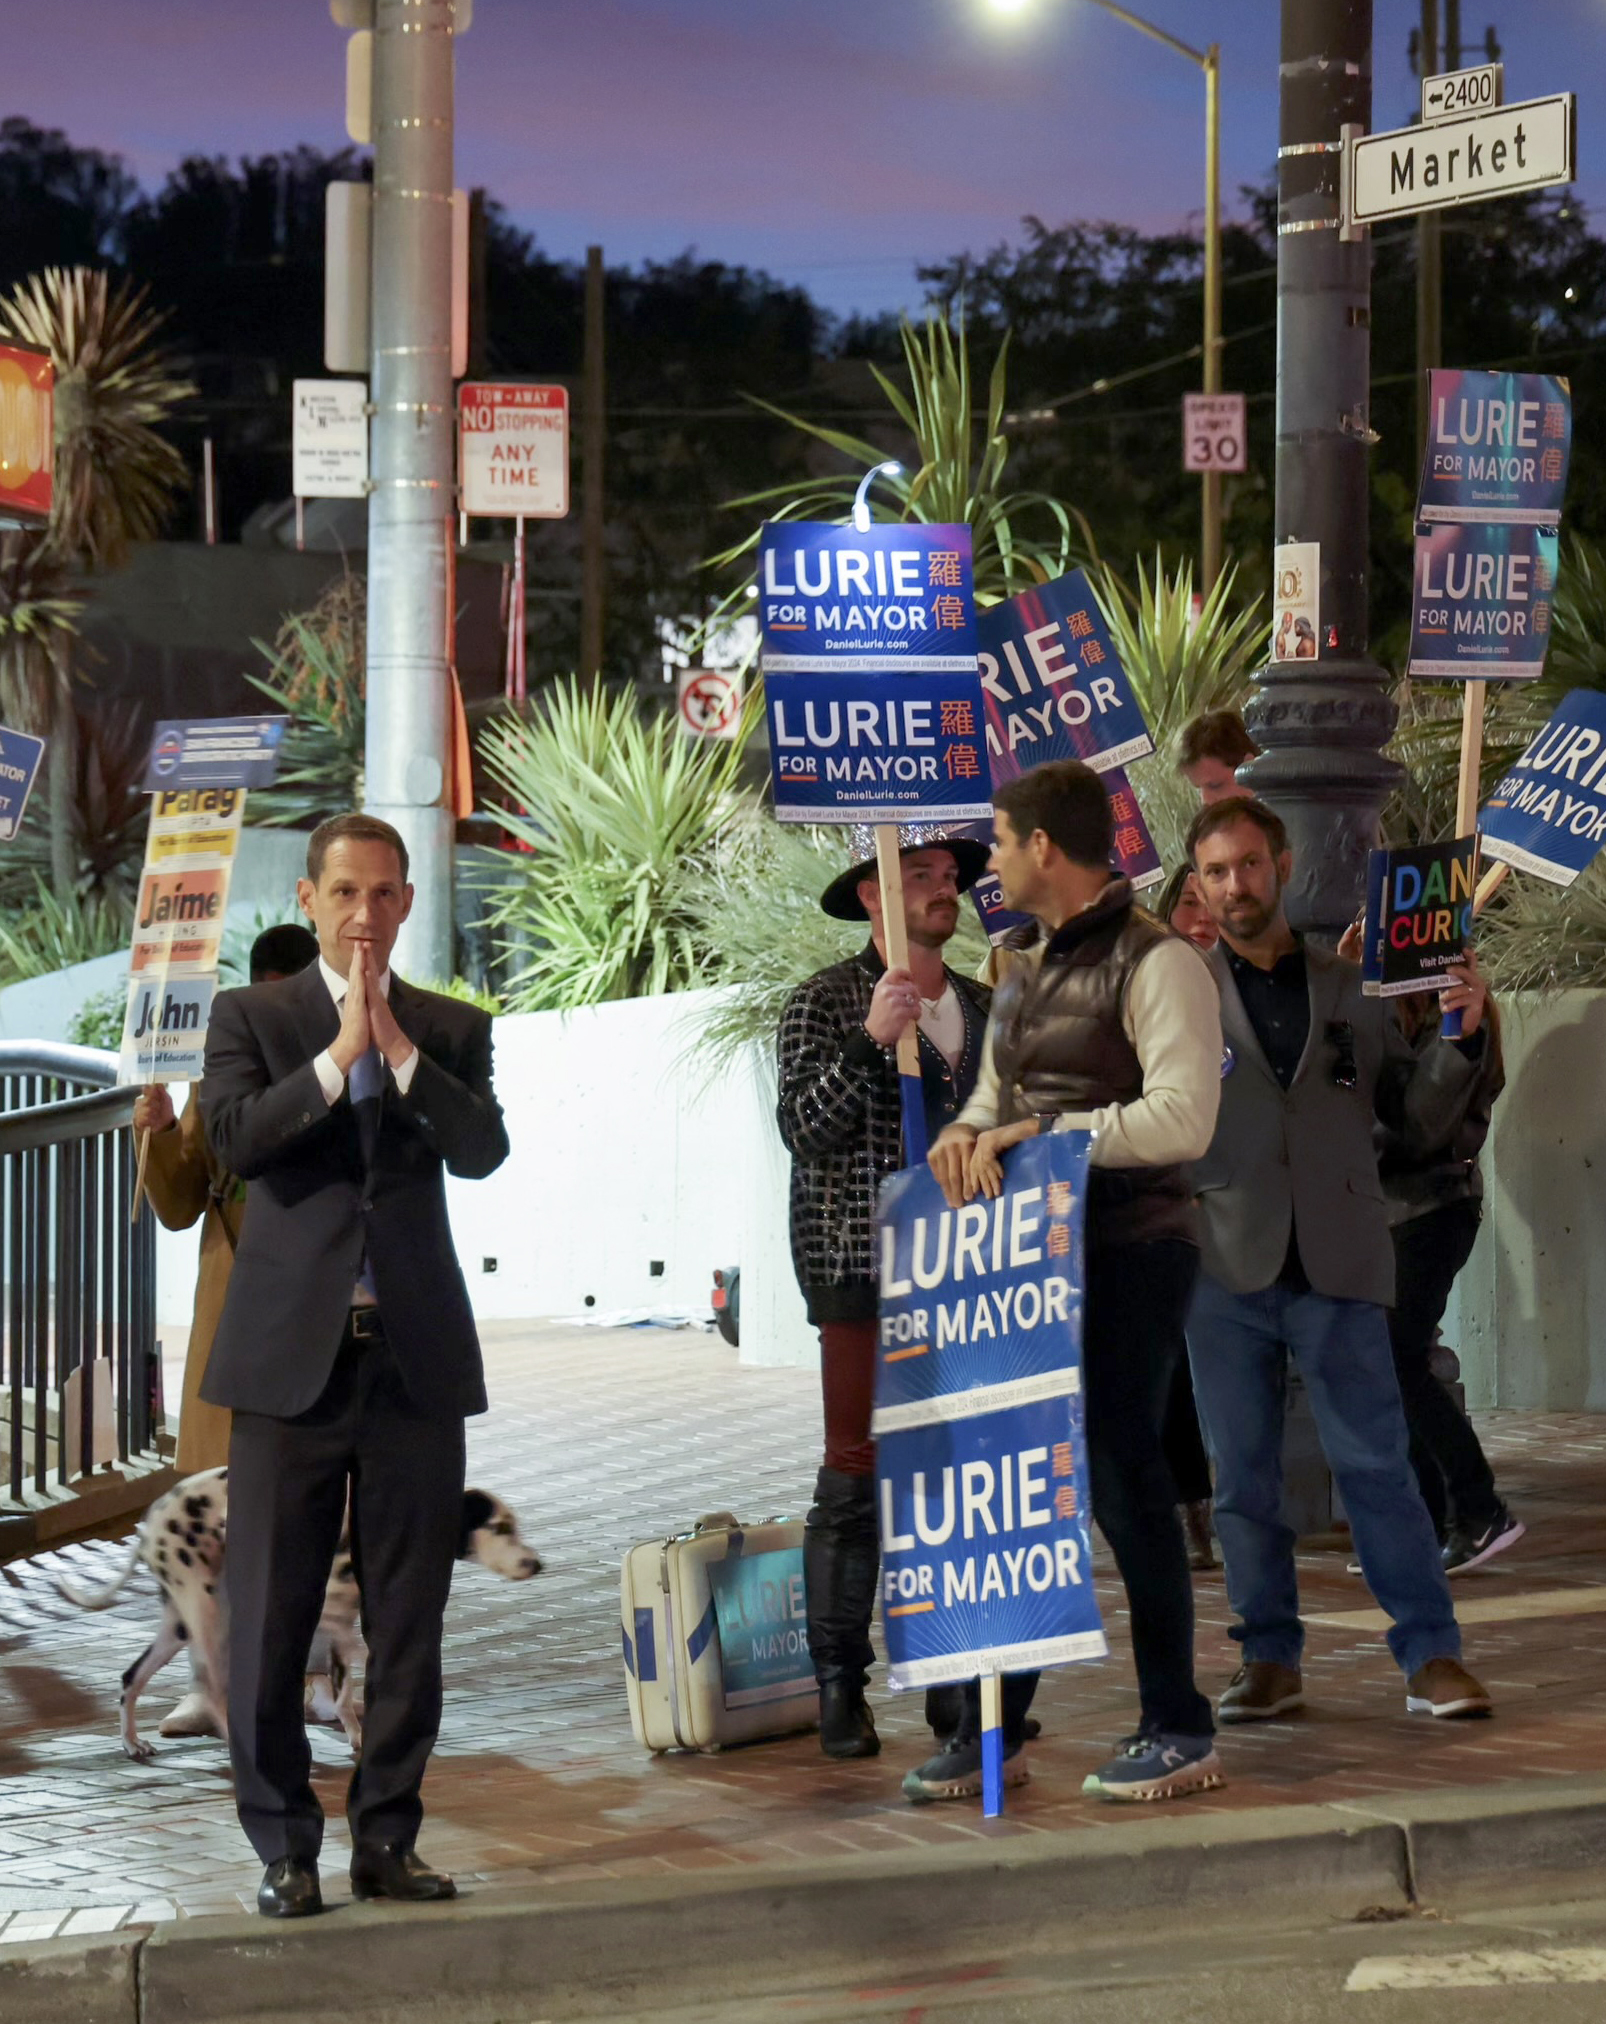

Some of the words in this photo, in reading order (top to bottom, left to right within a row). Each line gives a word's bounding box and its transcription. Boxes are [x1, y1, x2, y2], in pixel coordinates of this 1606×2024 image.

[1444, 73, 1491, 110] 2400
[1390, 123, 1526, 196] Market
[463, 406, 493, 431] NO
[496, 413, 562, 432] STOPPING
[1436, 397, 1541, 448] LURIE
[492, 444, 535, 461] ANY
[1193, 435, 1239, 464] 30
[489, 467, 539, 487] TIME
[1434, 454, 1463, 472] FOR
[1468, 456, 1535, 483] MAYOR
[764, 548, 924, 597] LURIE
[1421, 552, 1531, 601] LURIE
[767, 604, 807, 623] FOR
[815, 605, 928, 631] MAYOR
[1419, 608, 1448, 626] FOR
[1453, 609, 1526, 636] MAYOR
[825, 639, 908, 650] DanielLurie.com
[978, 621, 1079, 703] RIE
[773, 700, 936, 747] LURIE
[779, 756, 817, 773] FOR
[826, 756, 939, 781] MAYOR
[158, 787, 236, 818] Parag
[836, 790, 919, 801] DanielLurie.com
[1494, 777, 1525, 798] FOR
[140, 882, 220, 929] Jaime
[980, 889, 1004, 909] FO
[1420, 957, 1437, 968] Visit
[134, 991, 200, 1038] John
[163, 1051, 197, 1063] Education
[880, 1186, 1042, 1299] LURIE
[881, 1308, 929, 1347] FOR
[936, 1276, 1069, 1350] MAYOR
[880, 1446, 1052, 1553] LURIE
[884, 1564, 934, 1602] FOR
[943, 1538, 1083, 1608] MAYOR
[717, 1573, 807, 1632] LURIE
[752, 1627, 809, 1662] MAYOR
